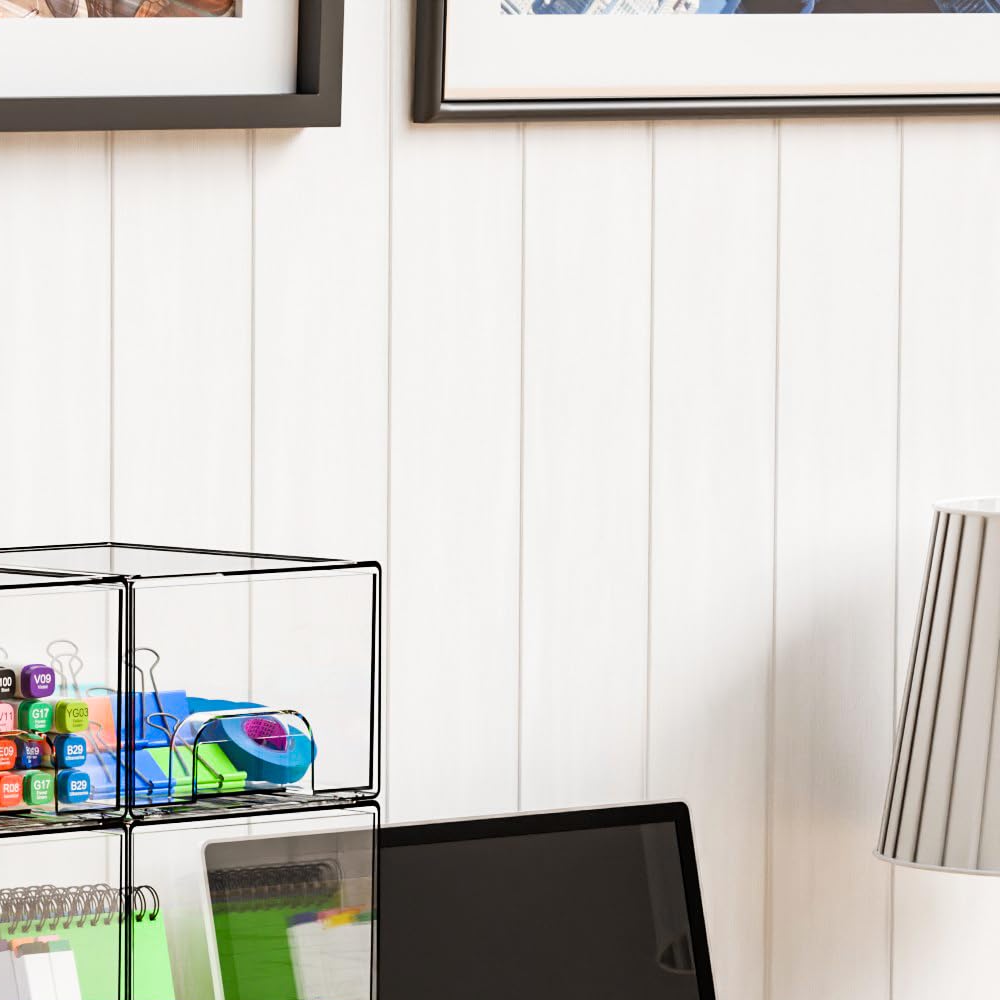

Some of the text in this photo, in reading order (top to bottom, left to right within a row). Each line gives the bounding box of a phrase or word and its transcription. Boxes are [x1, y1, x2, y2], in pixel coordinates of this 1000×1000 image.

[34, 674, 51, 684] V09
[32, 708, 49, 719] G17
[67, 708, 88, 718] YG03
[67, 745, 83, 755] B29
[3, 784, 19, 792] R08
[33, 780, 50, 790] G17
[70, 780, 87, 790] B29
